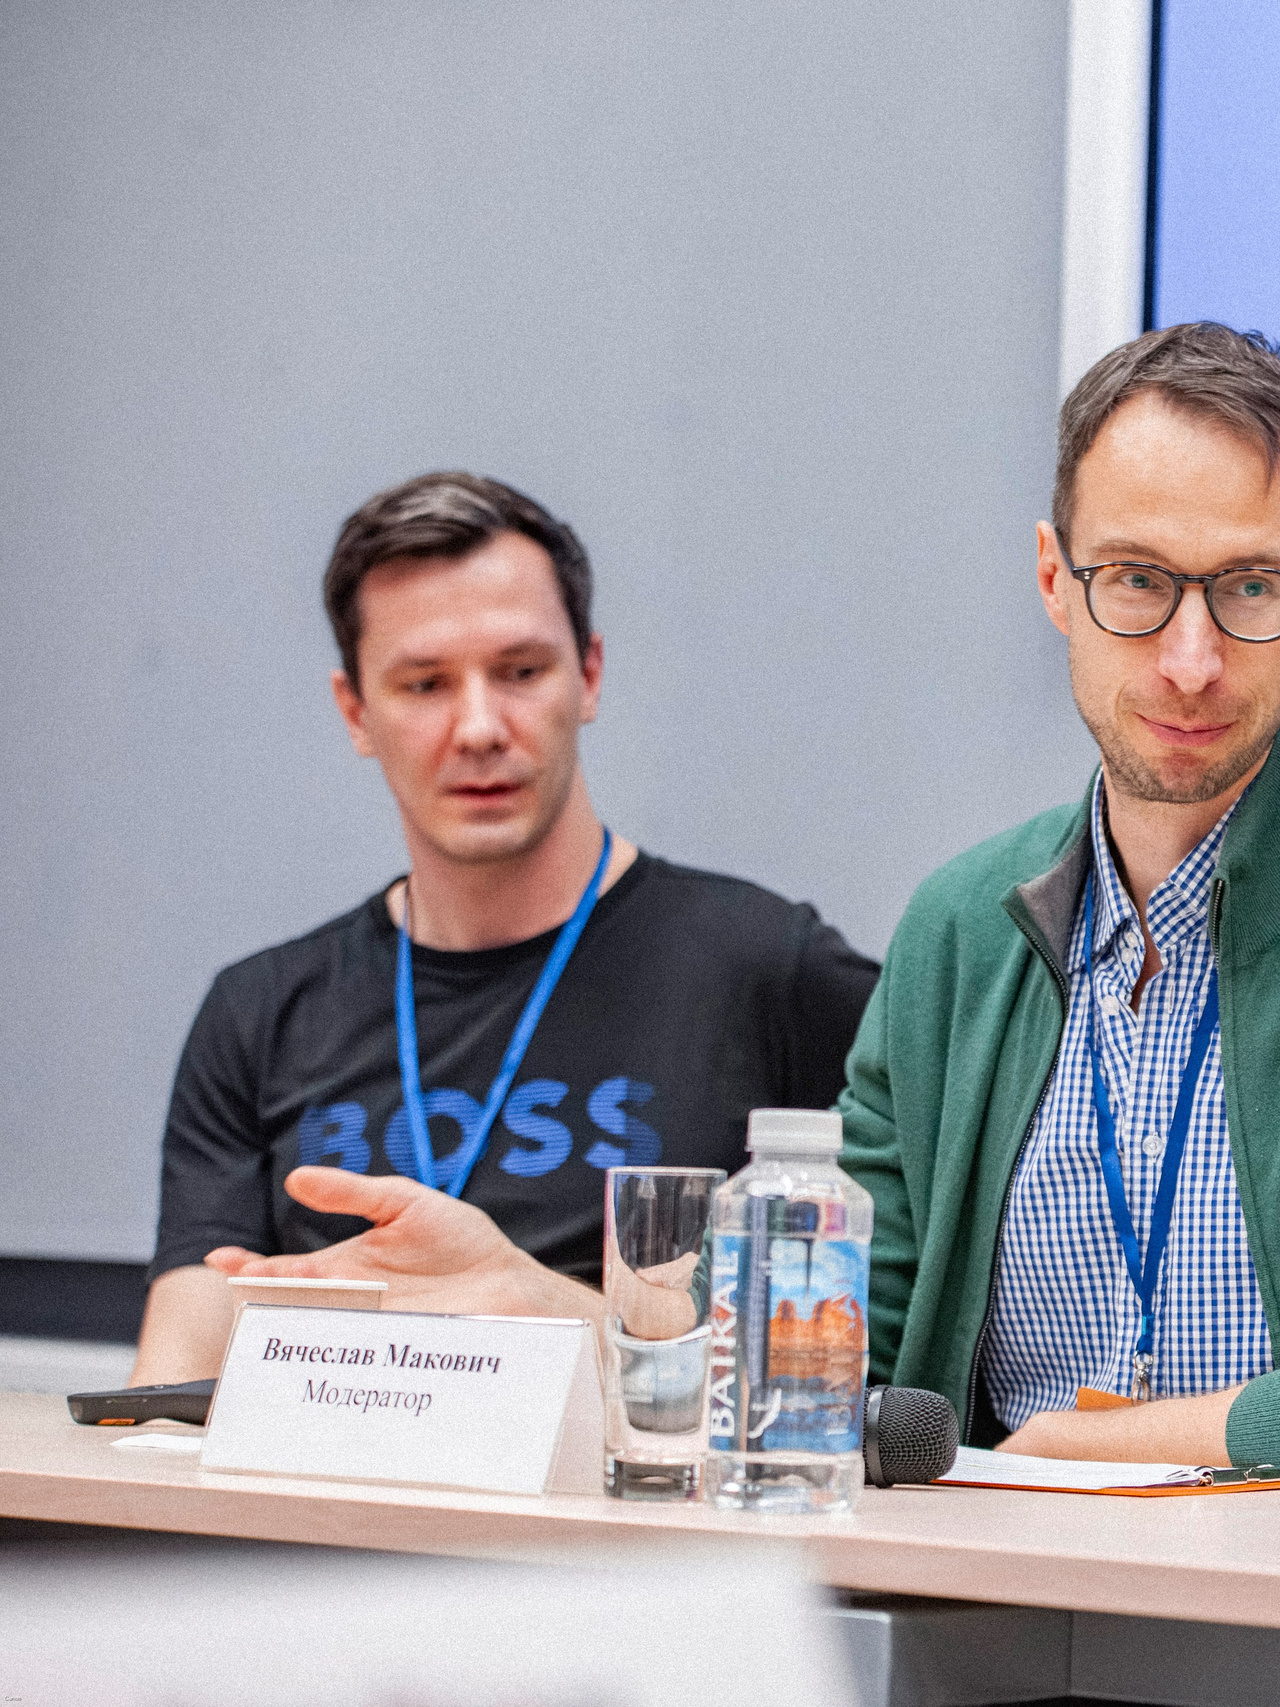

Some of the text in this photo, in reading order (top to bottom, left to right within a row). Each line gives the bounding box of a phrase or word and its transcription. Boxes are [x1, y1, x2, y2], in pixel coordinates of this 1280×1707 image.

[298, 1076, 662, 1186] BOSS
[262, 1337, 501, 1374] Вячеслав Макович
[709, 1250, 739, 1439] BAIKAL
[302, 1379, 432, 1417] Модератор
